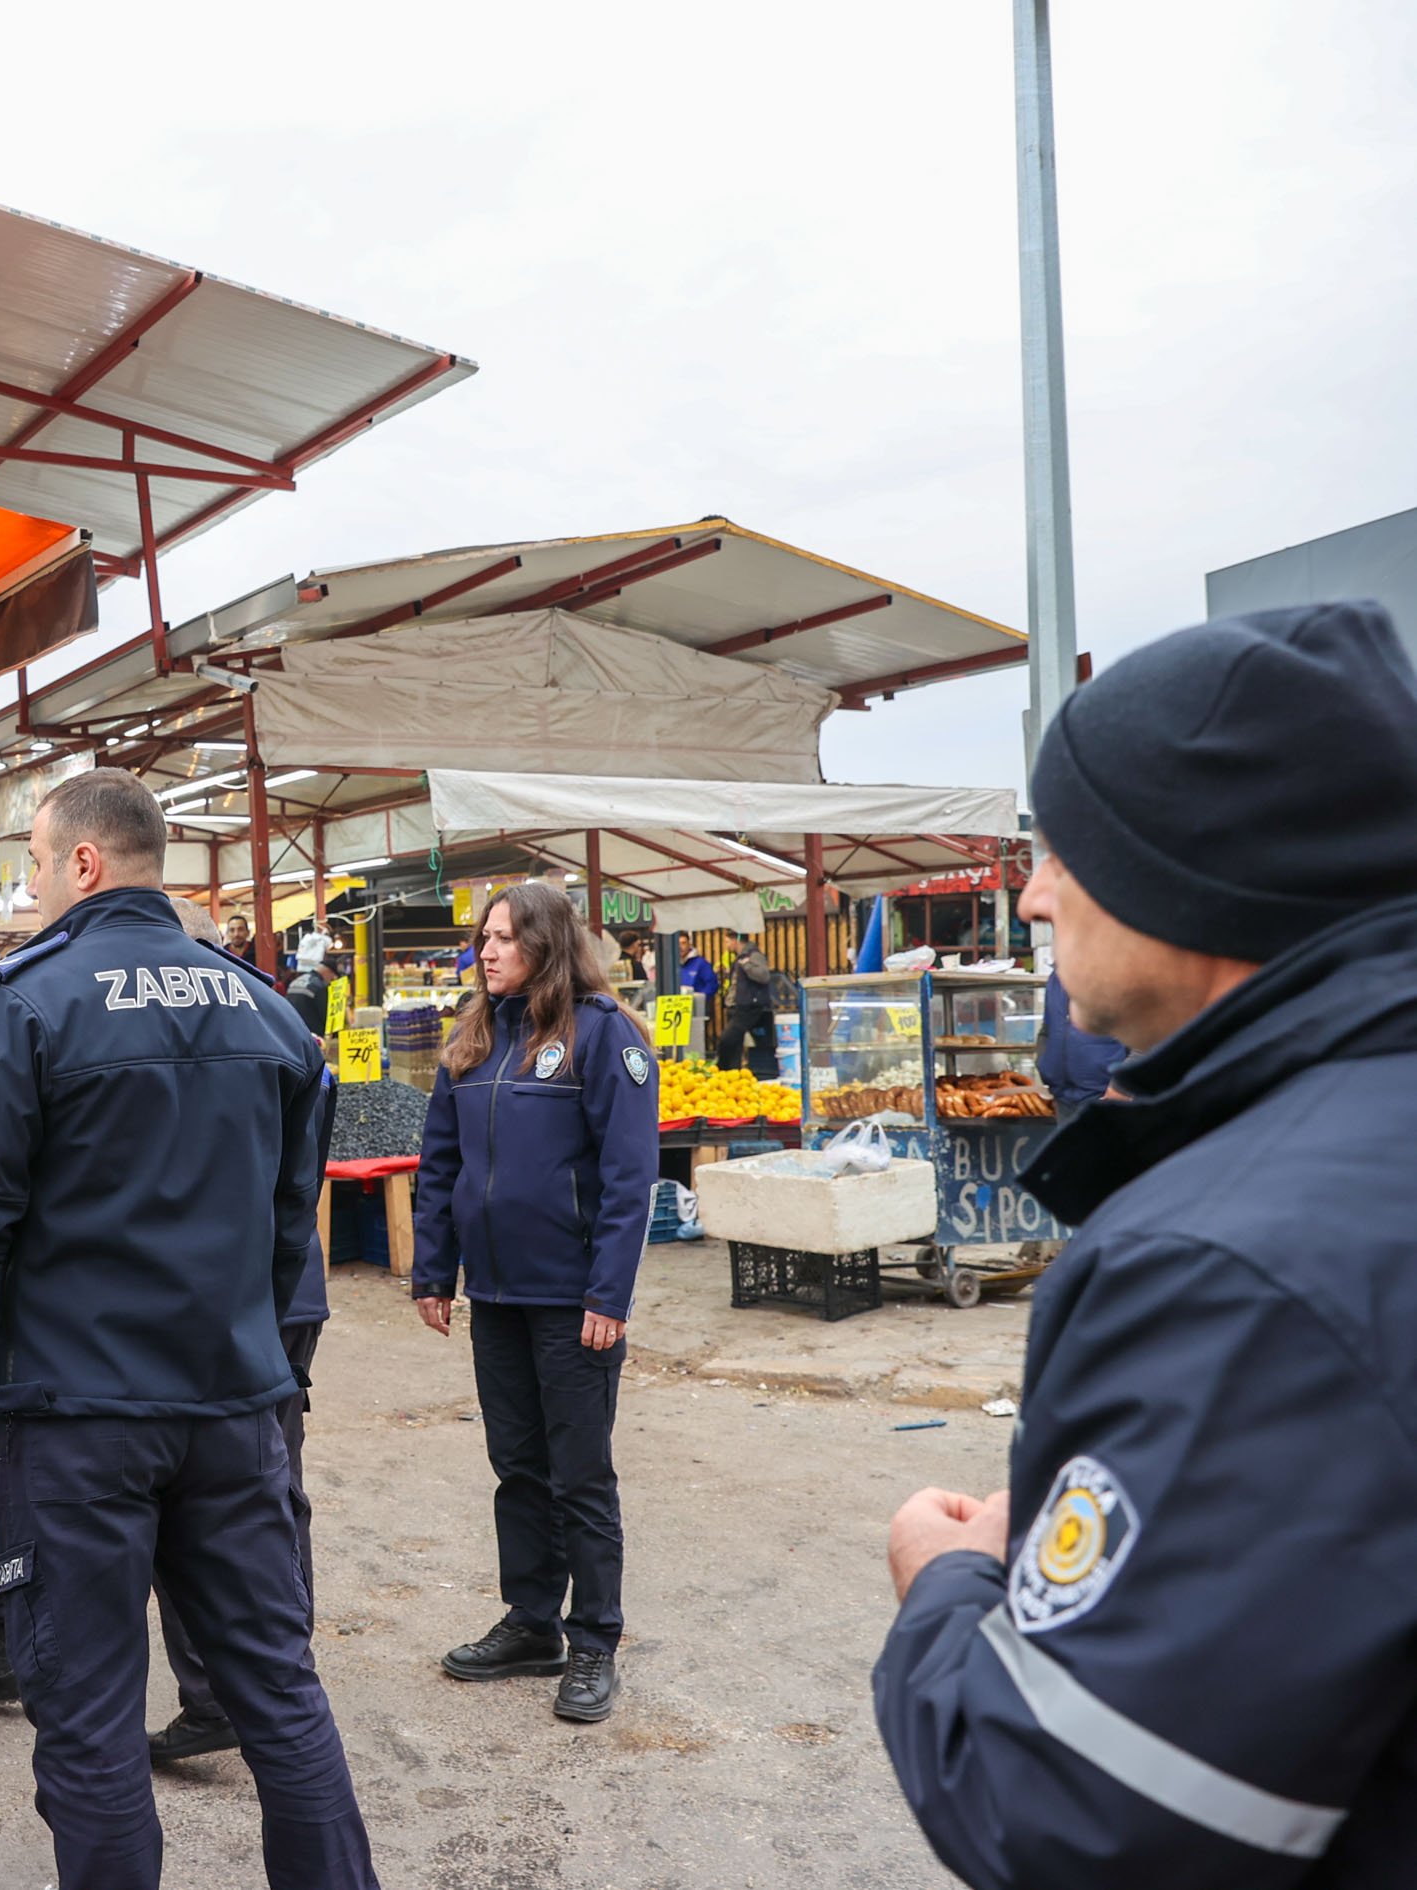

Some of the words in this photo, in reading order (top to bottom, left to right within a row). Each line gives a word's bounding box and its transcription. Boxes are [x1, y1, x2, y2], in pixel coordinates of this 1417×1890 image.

[94, 966, 259, 1012] ZABITA
[661, 1009, 682, 1031] 50
[346, 1046, 371, 1065] 70
